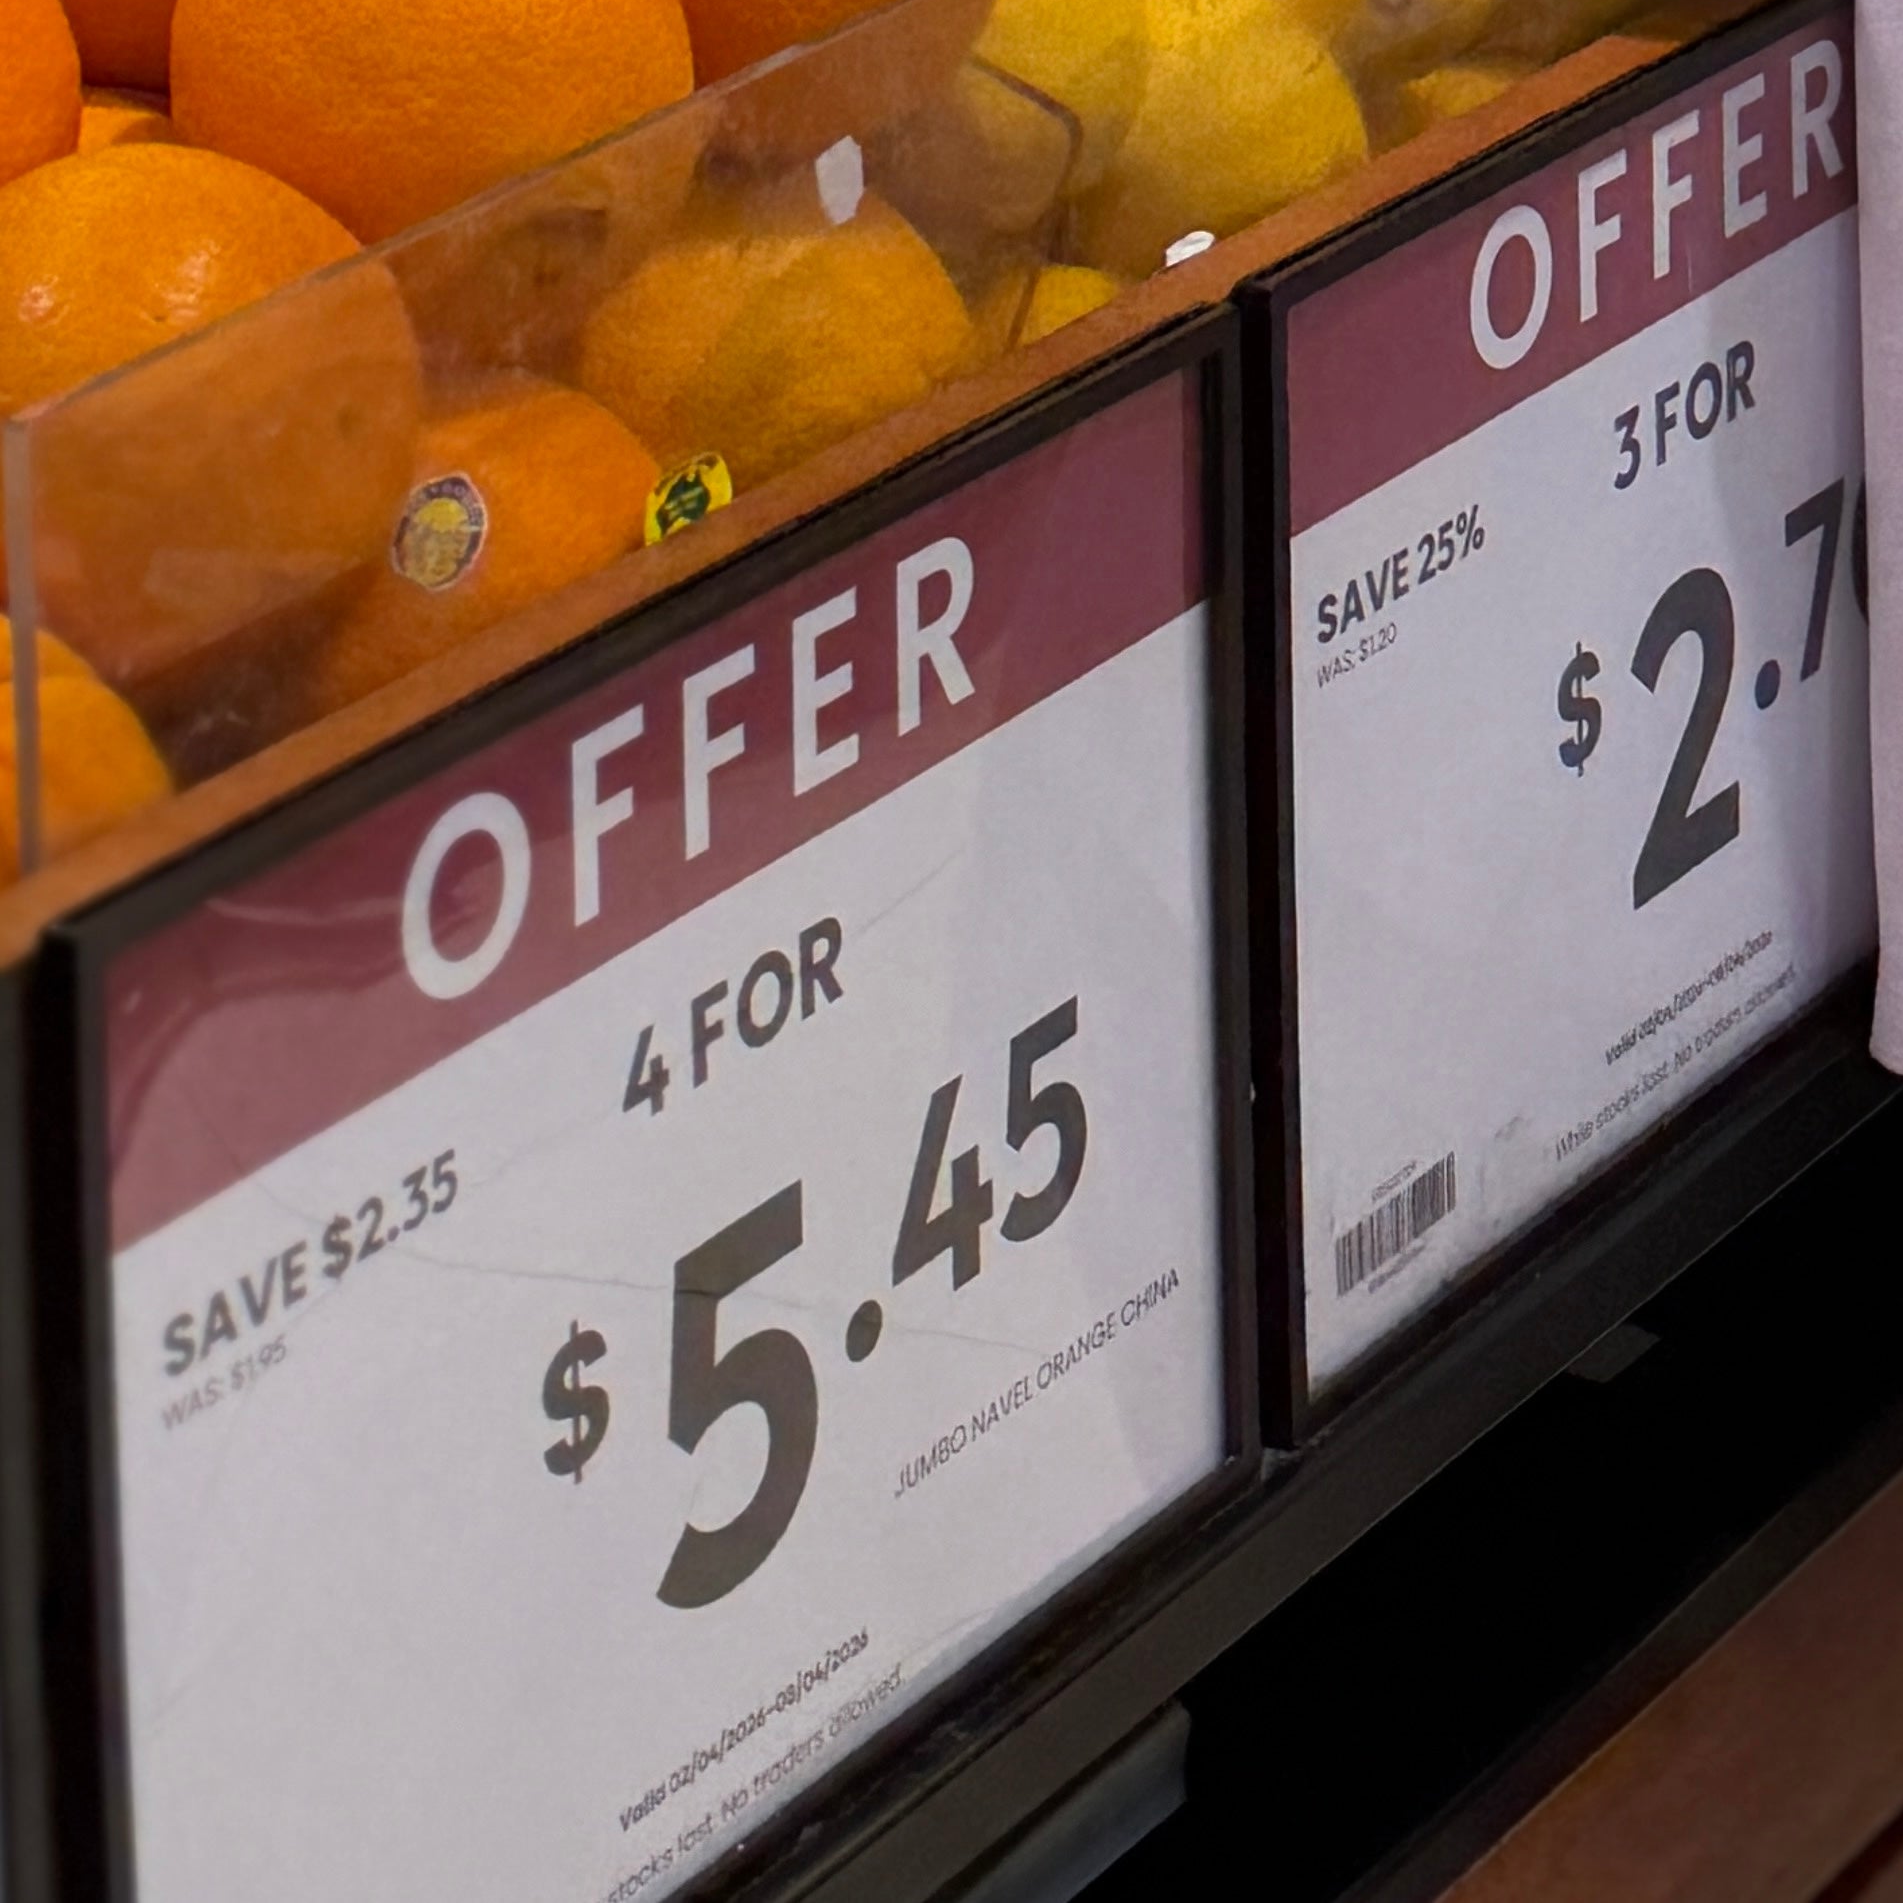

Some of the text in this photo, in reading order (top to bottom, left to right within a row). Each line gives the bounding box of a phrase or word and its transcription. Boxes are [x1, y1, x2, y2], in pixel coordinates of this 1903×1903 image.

[1470, 38, 1846, 370] OFFER
[1613, 340, 1757, 491] 3 FOR
[1317, 503, 1486, 644] SAVE 25%
[403, 537, 976, 1000] OFFER
[1557, 470, 1870, 911] $2.7
[622, 917, 846, 1116] 4 FOR
[163, 1148, 458, 1377] SAVE $2.35
[894, 1267, 1180, 1499] JUMBO NAVEL ORANGE CHINA
[619, 1783, 668, 1832] Valid
[721, 1788, 749, 1823] No
